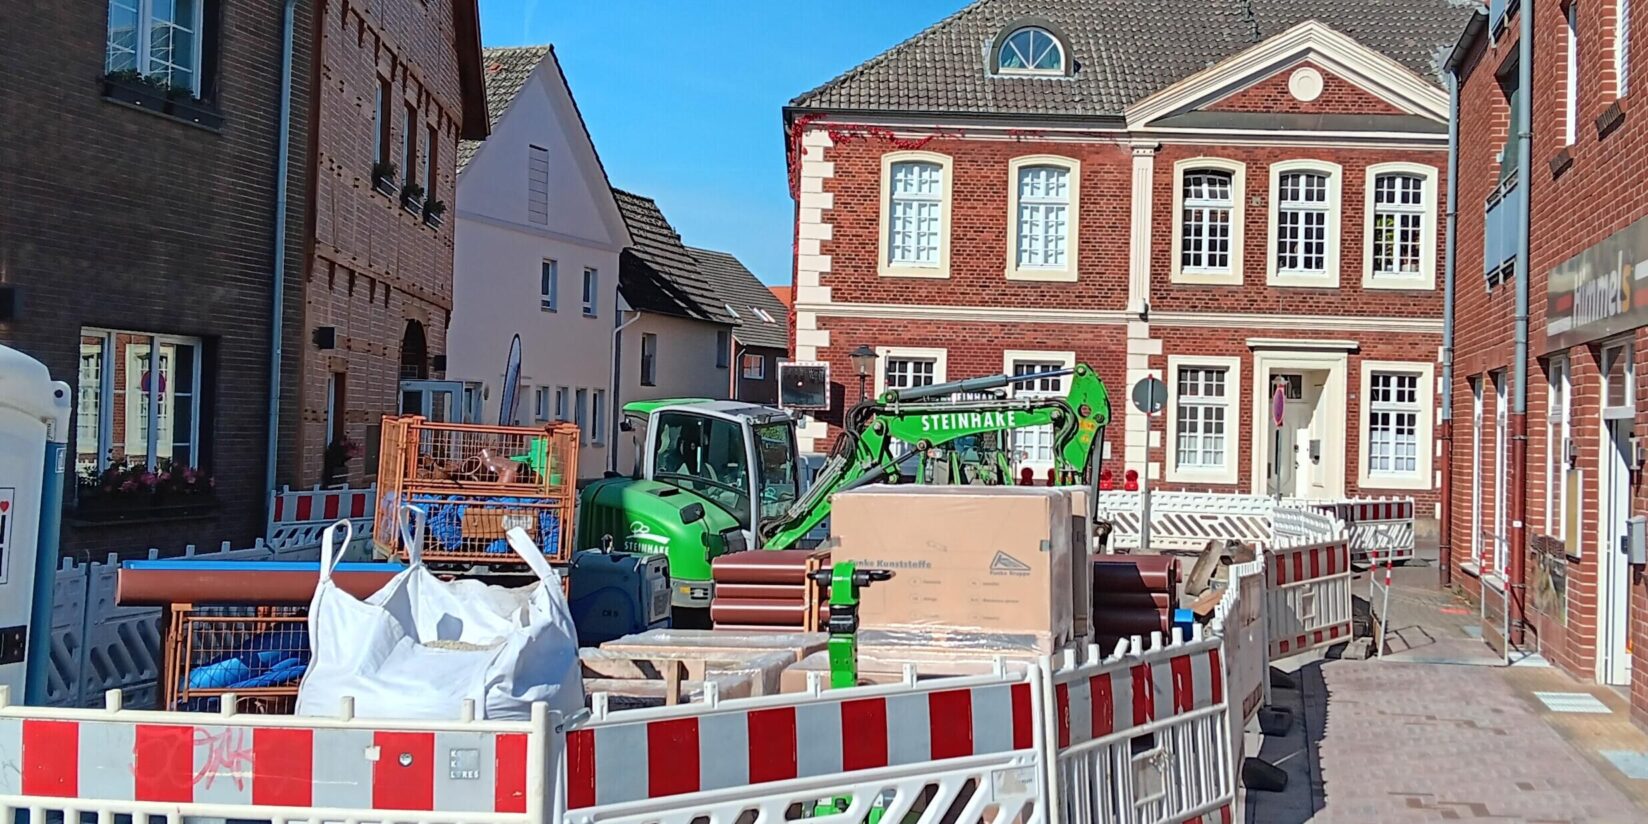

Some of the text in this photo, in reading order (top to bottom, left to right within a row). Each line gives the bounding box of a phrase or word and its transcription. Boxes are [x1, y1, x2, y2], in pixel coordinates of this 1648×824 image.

[1573, 250, 1631, 328] Himmels
[921, 411, 1016, 431] STEINHAKE
[624, 541, 670, 555] STEINHAKE
